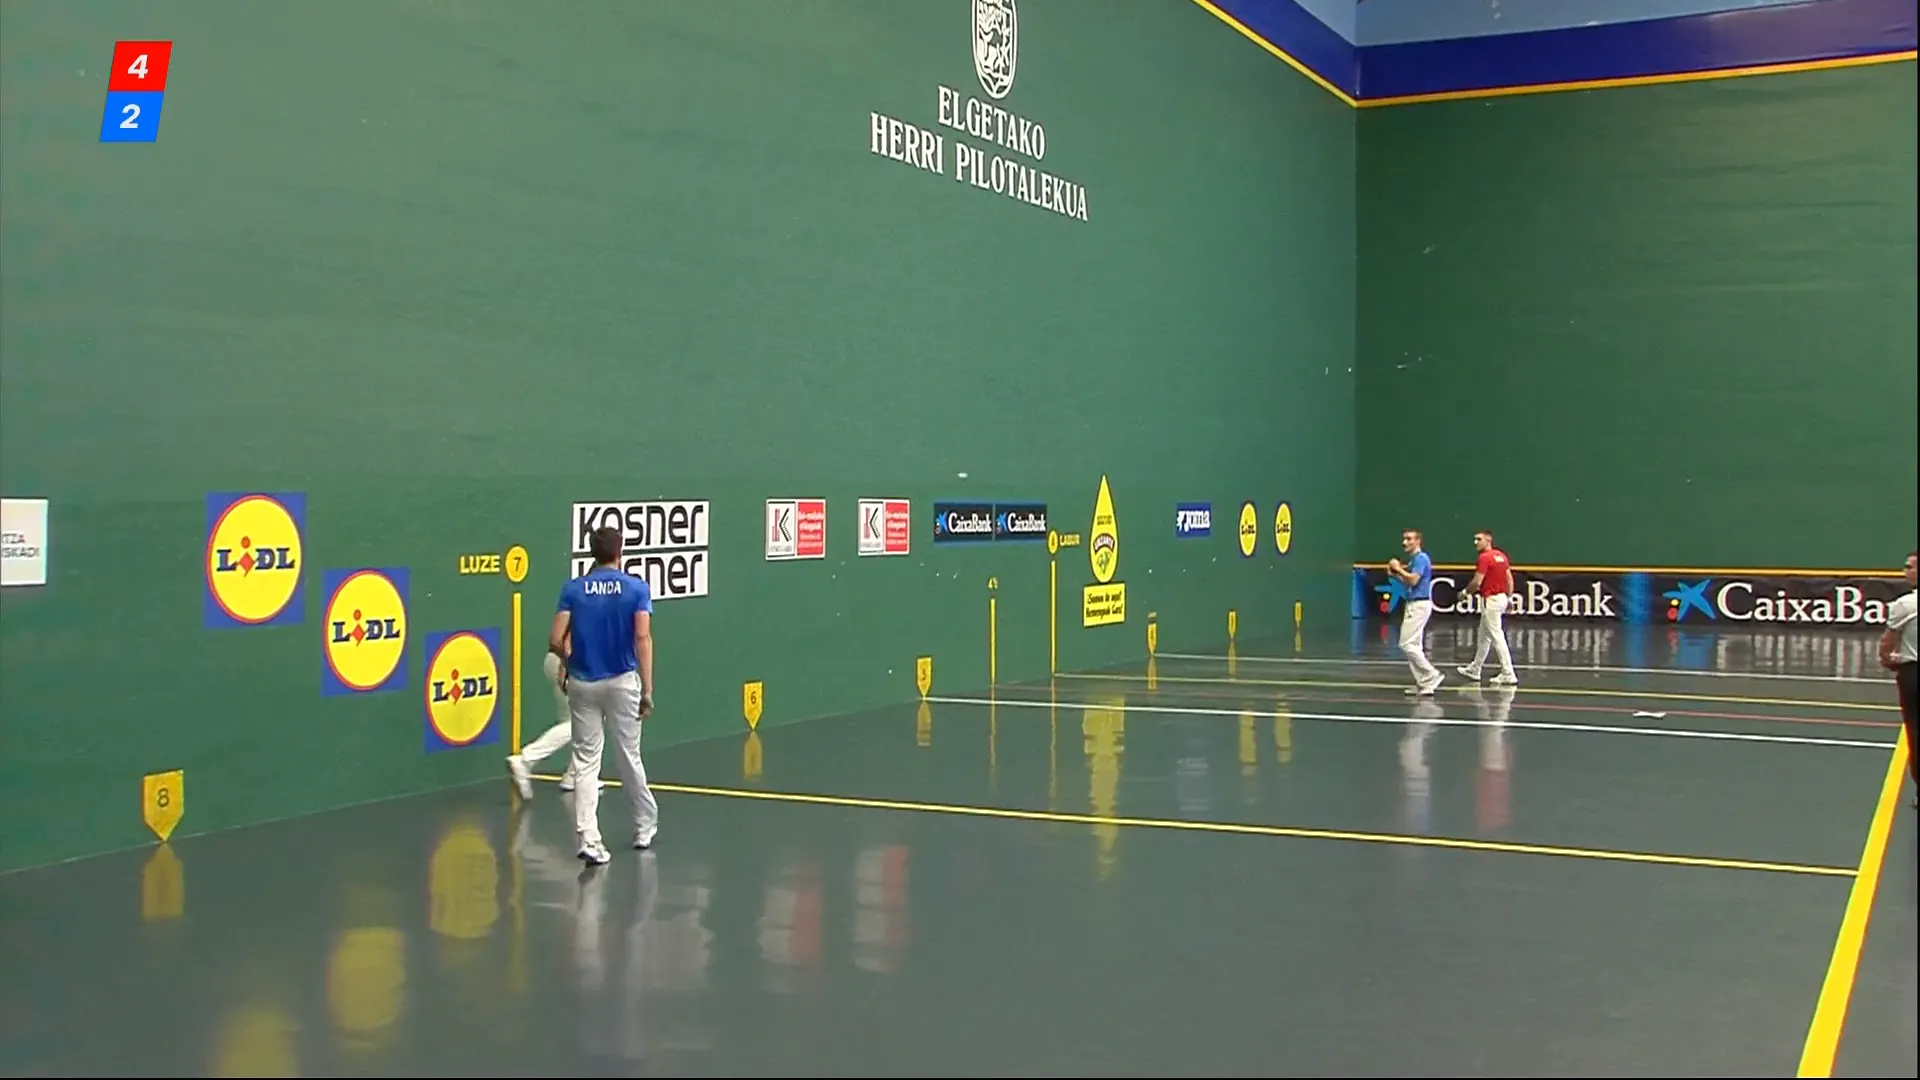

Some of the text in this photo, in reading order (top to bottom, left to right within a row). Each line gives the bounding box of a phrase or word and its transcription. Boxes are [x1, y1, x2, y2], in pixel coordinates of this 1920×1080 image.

[938, 85, 1046, 160] ELGETAKO
[870, 112, 1088, 221] HERRI PILOTALEKUA
[948, 512, 992, 533] CaixaBank
[1007, 512, 1046, 533] CaixaBank
[459, 554, 522, 574] LUZE 7
[584, 580, 622, 595] LANDA
[1717, 582, 1893, 624] CaixaBa
[157, 787, 170, 808] 8
